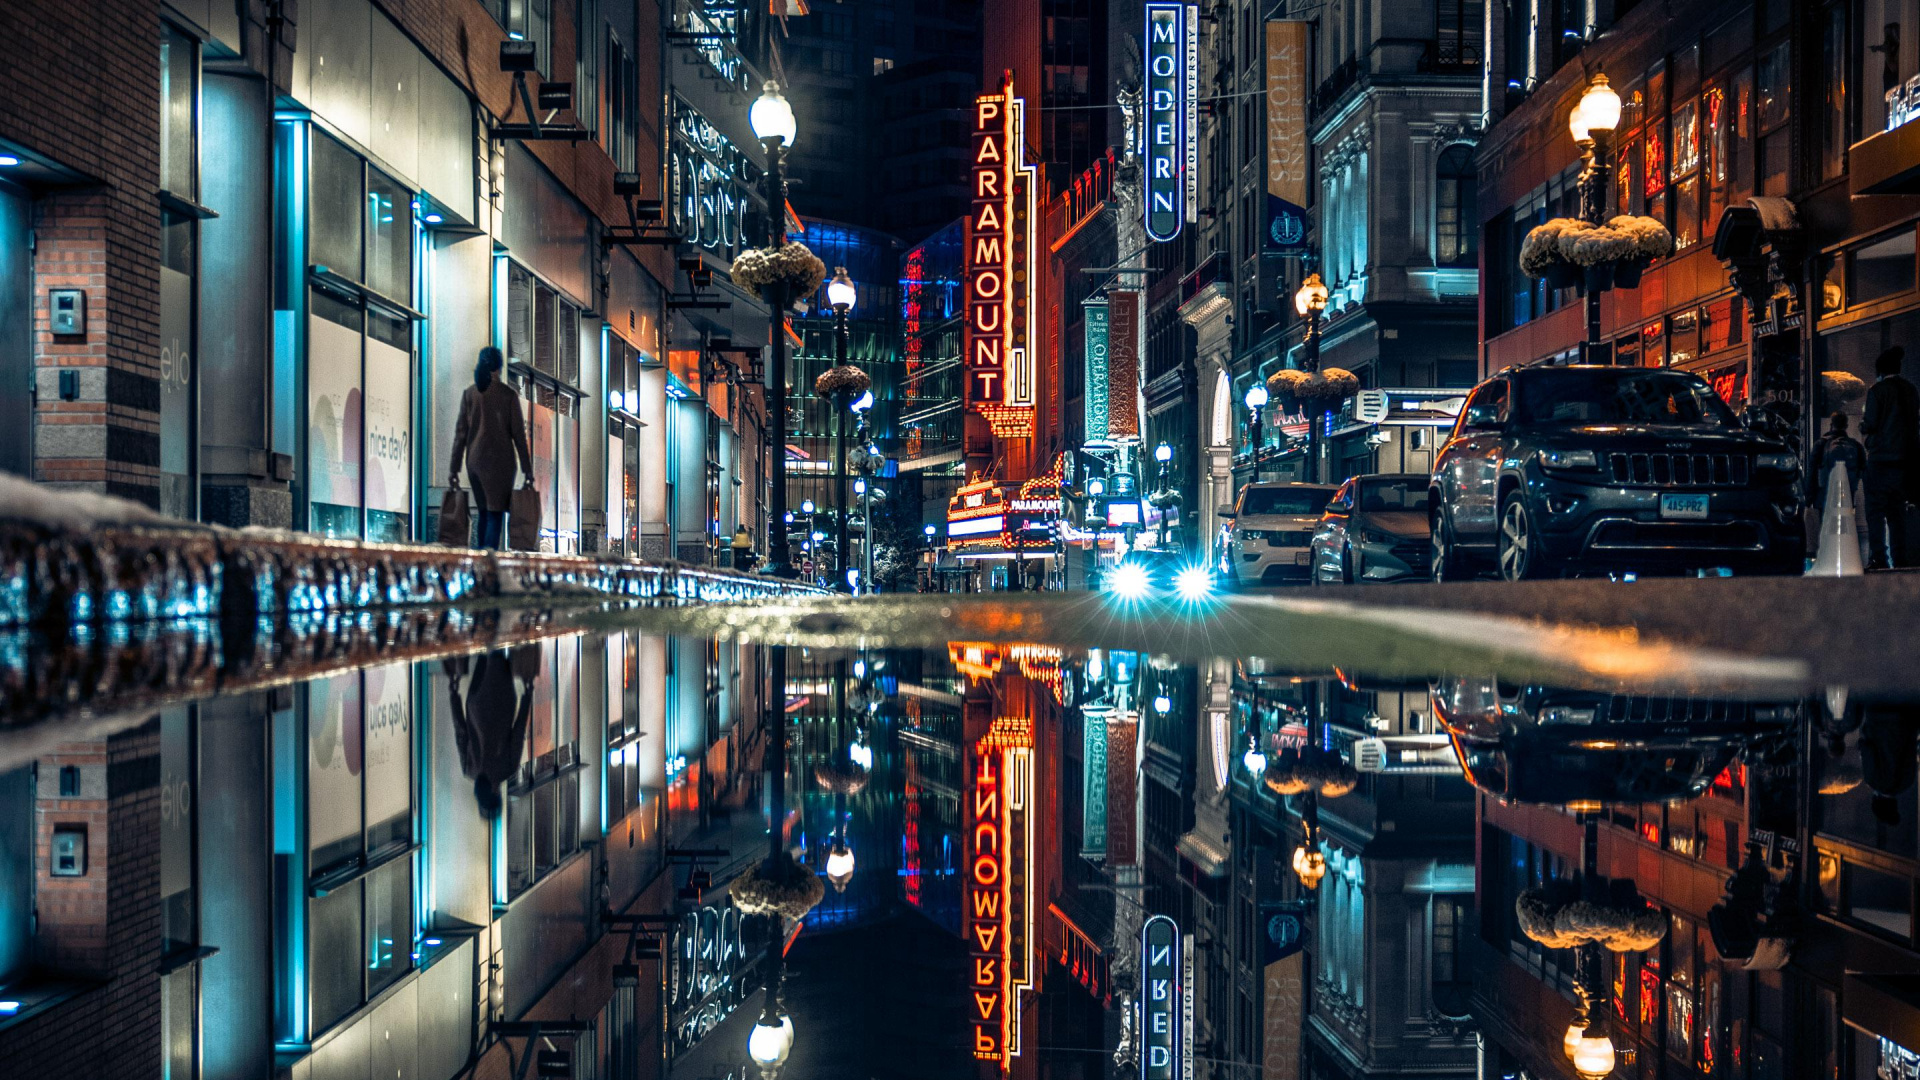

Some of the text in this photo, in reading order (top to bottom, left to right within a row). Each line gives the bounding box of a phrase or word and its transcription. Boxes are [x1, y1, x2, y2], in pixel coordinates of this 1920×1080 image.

[1188, 31, 1196, 119] UNIVERSITY
[1153, 23, 1175, 212] MODERN
[1269, 44, 1291, 182] SUFFOLK
[1291, 44, 1305, 182] UNIVERSITY
[975, 103, 1001, 398] PARAMOUNT
[161, 338, 190, 385] ello
[1113, 296, 1133, 358] BALLET
[1093, 344, 1107, 439] OPERA HOUSE
[1272, 412, 1297, 427] BACK
[370, 425, 408, 470] nice day?
[1265, 464, 1283, 472] WEST
[1011, 500, 1060, 511] PARAMOUNT
